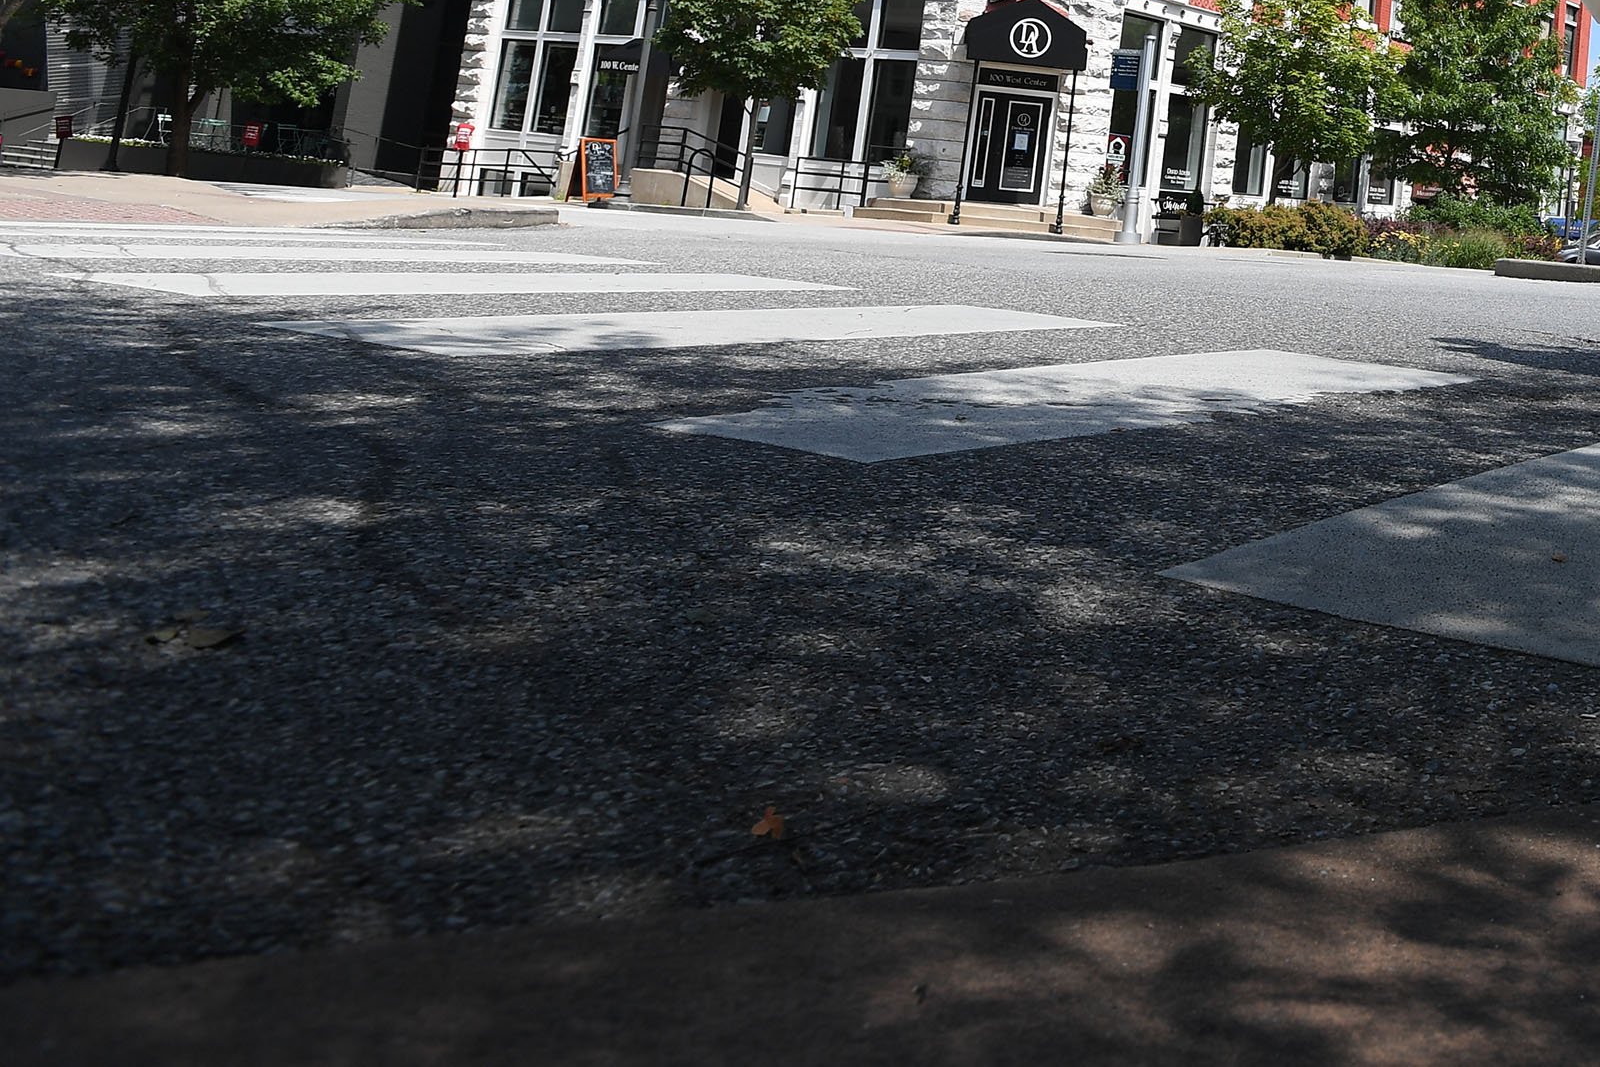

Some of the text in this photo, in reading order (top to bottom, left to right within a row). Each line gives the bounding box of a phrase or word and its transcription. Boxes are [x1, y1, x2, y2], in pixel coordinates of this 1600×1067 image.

[600, 61, 611, 69] 100
[620, 61, 640, 71] Cente
[990, 74, 1048, 87] 100 West Center
